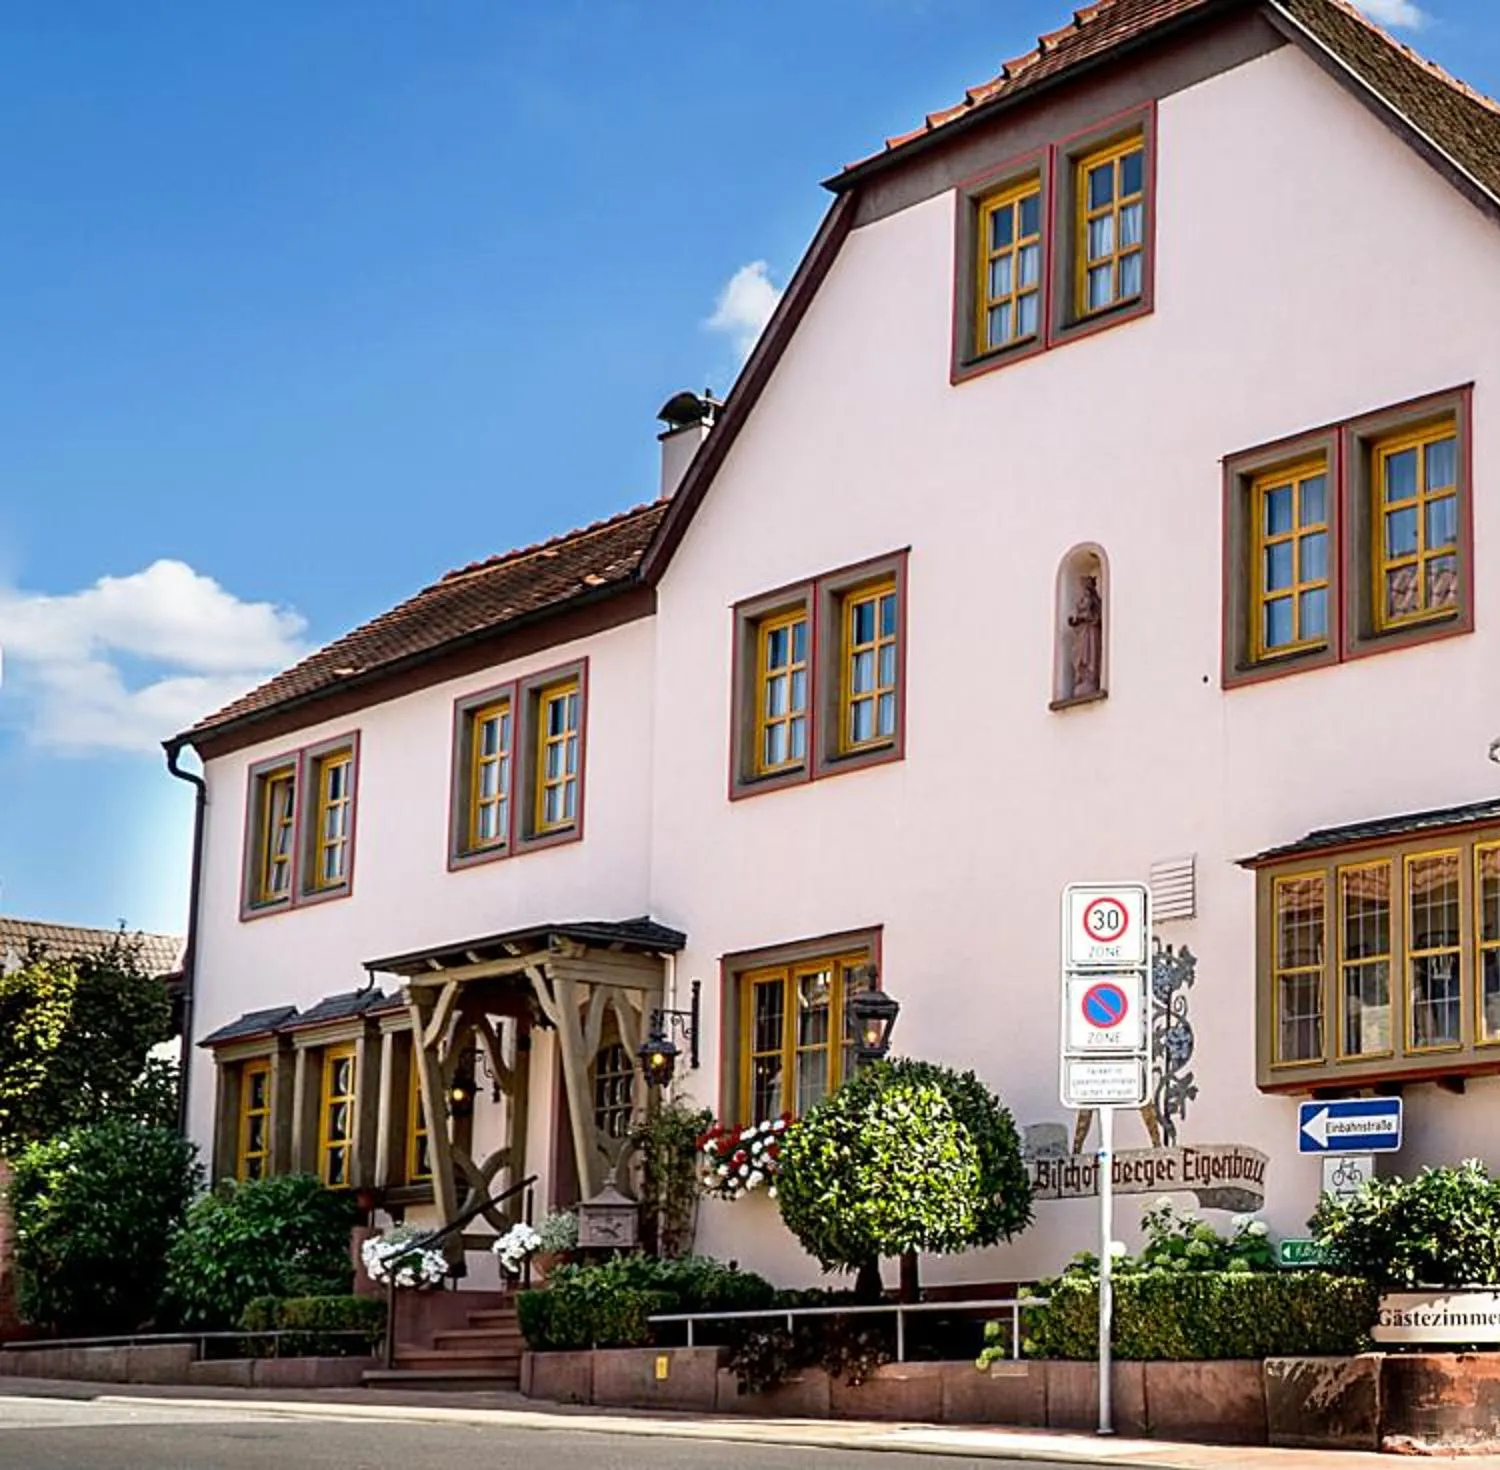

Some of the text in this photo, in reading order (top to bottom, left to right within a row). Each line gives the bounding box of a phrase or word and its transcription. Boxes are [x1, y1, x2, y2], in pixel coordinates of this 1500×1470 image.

[1093, 909, 1119, 931] 30
[1088, 945, 1121, 958] ZONE
[1087, 1031, 1121, 1044] ZONE
[1326, 1119, 1392, 1134] Einbahnstraße
[1182, 1148, 1267, 1186] Eigenbau
